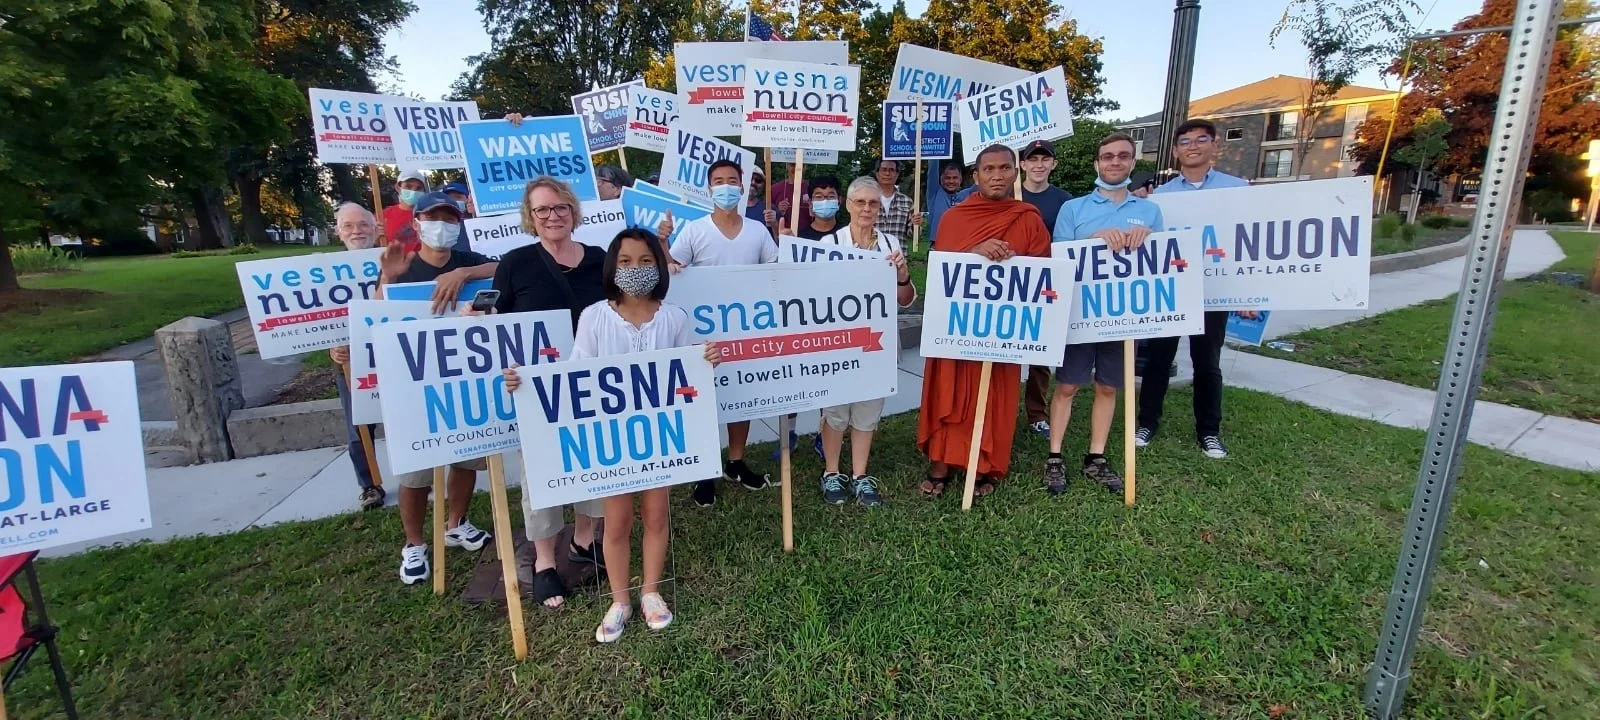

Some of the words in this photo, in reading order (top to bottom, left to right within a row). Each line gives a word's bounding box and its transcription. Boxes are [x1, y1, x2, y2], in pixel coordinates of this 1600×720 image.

[754, 69, 848, 91] vesna
[899, 66, 962, 100] VESNA
[706, 105, 736, 114] make
[753, 89, 848, 112] nuon
[968, 76, 1054, 121] VESNA
[321, 114, 387, 133] nuo
[393, 106, 468, 130] VESNA
[891, 105, 948, 123] SUSIE
[979, 101, 1049, 143] NUON
[752, 124, 777, 132] make
[811, 127, 845, 136] happen
[1022, 122, 1057, 138] AT-LARGE
[478, 132, 573, 158] WAYNE
[677, 129, 743, 166] VESNA
[889, 144, 913, 152] SCHOOL
[476, 154, 586, 183] JENNESS
[489, 184, 505, 192] CITY
[667, 180, 682, 188] CITY
[1235, 216, 1359, 262] NUON
[1067, 238, 1188, 282] VESNA
[1236, 263, 1322, 276] AT-LARGE
[252, 261, 379, 290] vesna
[942, 262, 1058, 304] VESNA
[1081, 277, 1176, 319] NUON
[276, 314, 312, 326] lowell
[316, 311, 337, 319] city
[948, 301, 1043, 341] NUON
[1070, 321, 1091, 330] CITY
[1093, 318, 1135, 328] COUNCIL
[1138, 314, 1186, 324] AT-LARGE
[271, 329, 300, 340] MAKE
[305, 322, 348, 334] LOWELL
[397, 321, 560, 381] VESNA
[751, 341, 785, 355] city
[791, 332, 853, 350] council
[934, 337, 954, 346] CITY
[957, 338, 998, 349] COUNCIL
[1001, 343, 1047, 352] AT-LARGE
[737, 364, 793, 385] lowell
[799, 357, 860, 378] happen
[532, 358, 697, 424] VESNA
[720, 388, 830, 412] VesnaForLowell.com
[411, 436, 442, 451] CITY
[446, 427, 504, 444] COUNCIL
[559, 409, 686, 473] NUON
[547, 475, 576, 489] CITY
[580, 467, 638, 482] COUNCIL
[641, 455, 700, 473] AT-LARGE
[587, 474, 672, 493] VESNAFORLOWELL.COM
[0, 499, 111, 528] AT-LARGE
